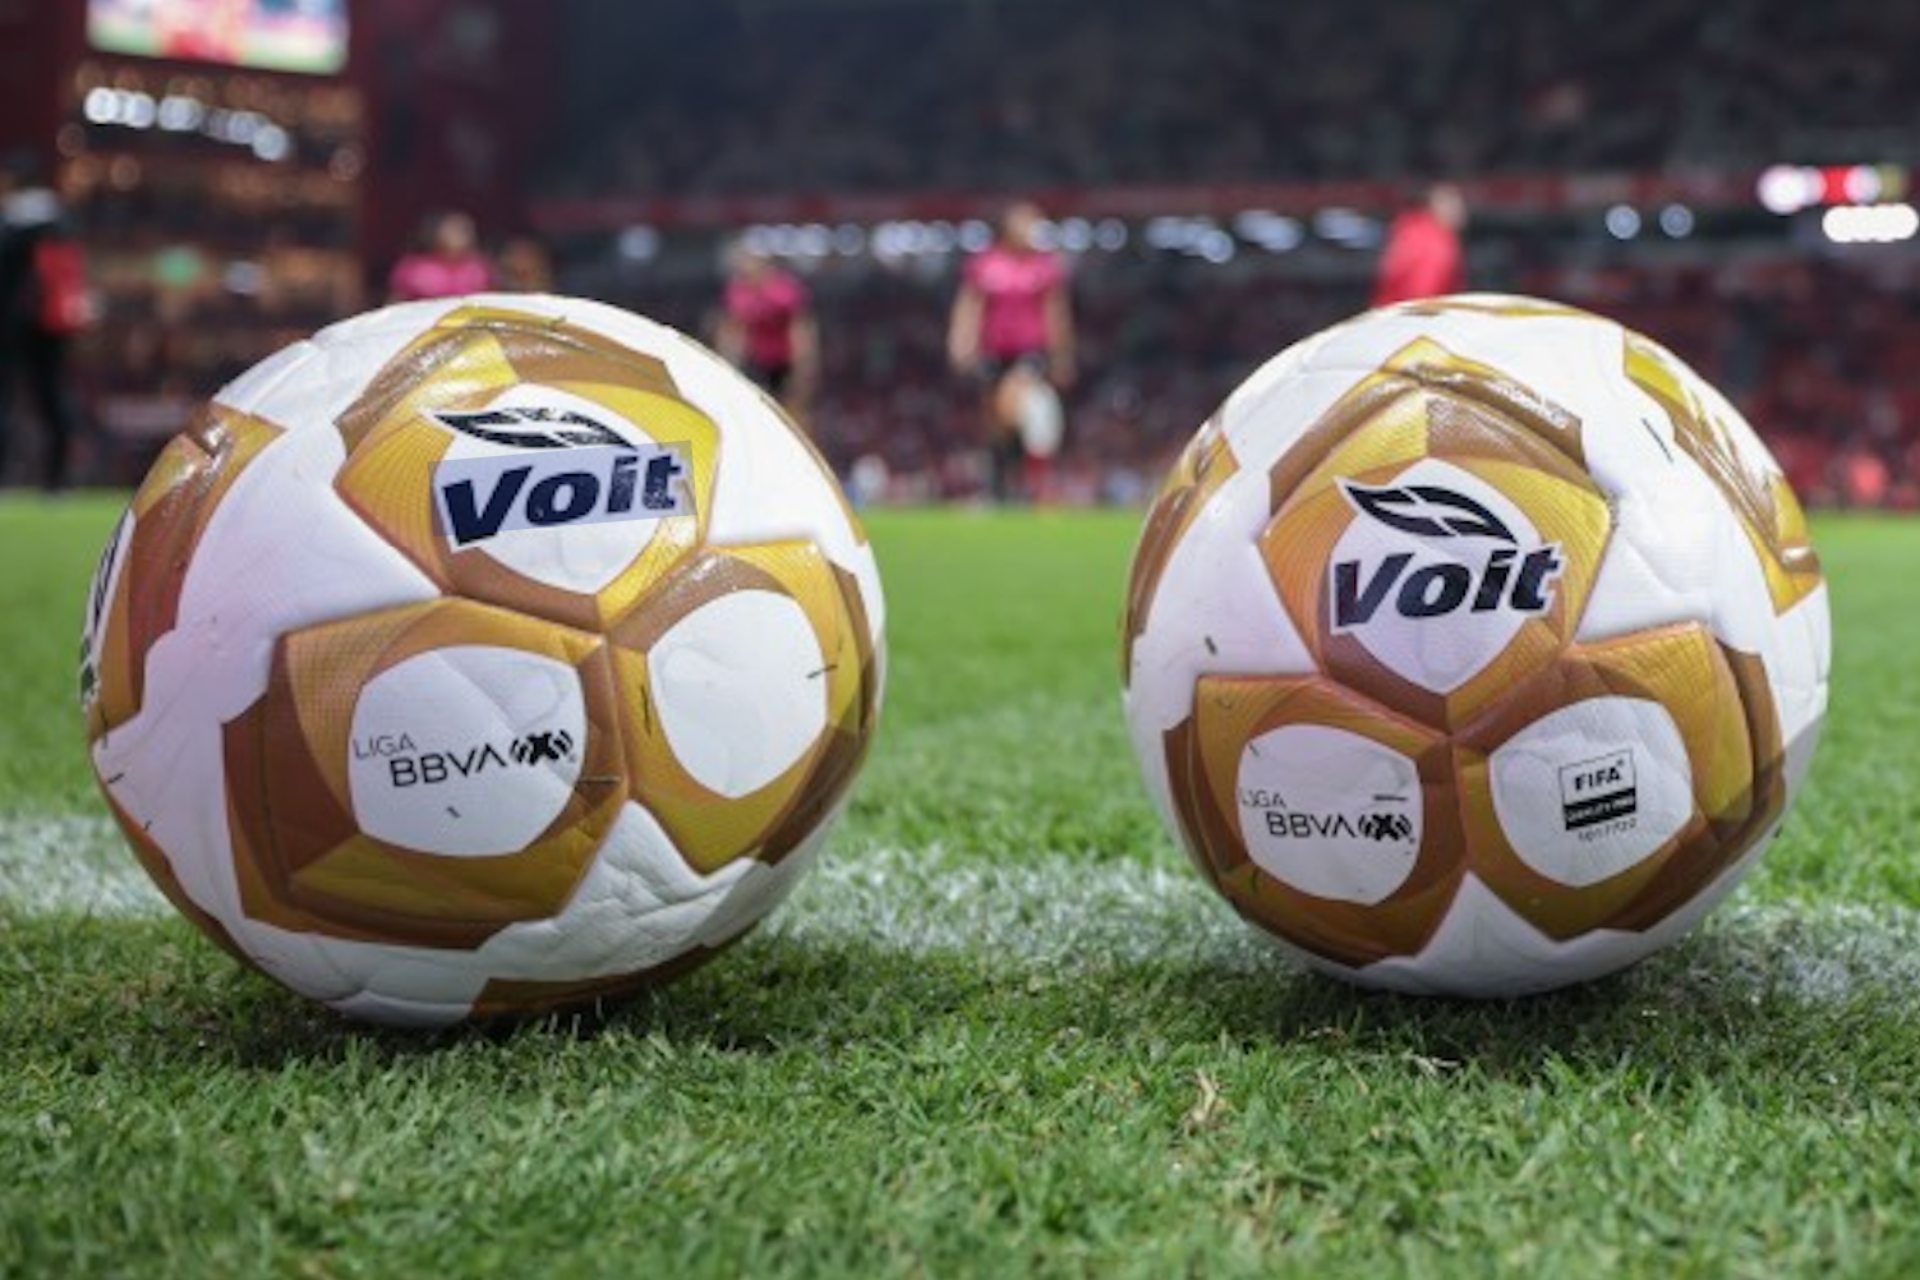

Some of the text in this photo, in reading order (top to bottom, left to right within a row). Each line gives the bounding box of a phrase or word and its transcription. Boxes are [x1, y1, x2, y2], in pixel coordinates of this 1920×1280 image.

[442, 455, 682, 546] Voit
[1335, 547, 1560, 627] Voit
[352, 733, 417, 760] LIGA
[390, 743, 508, 787] BBVA
[1575, 767, 1621, 791] FIFA
[1266, 812, 1357, 838] BBVA
